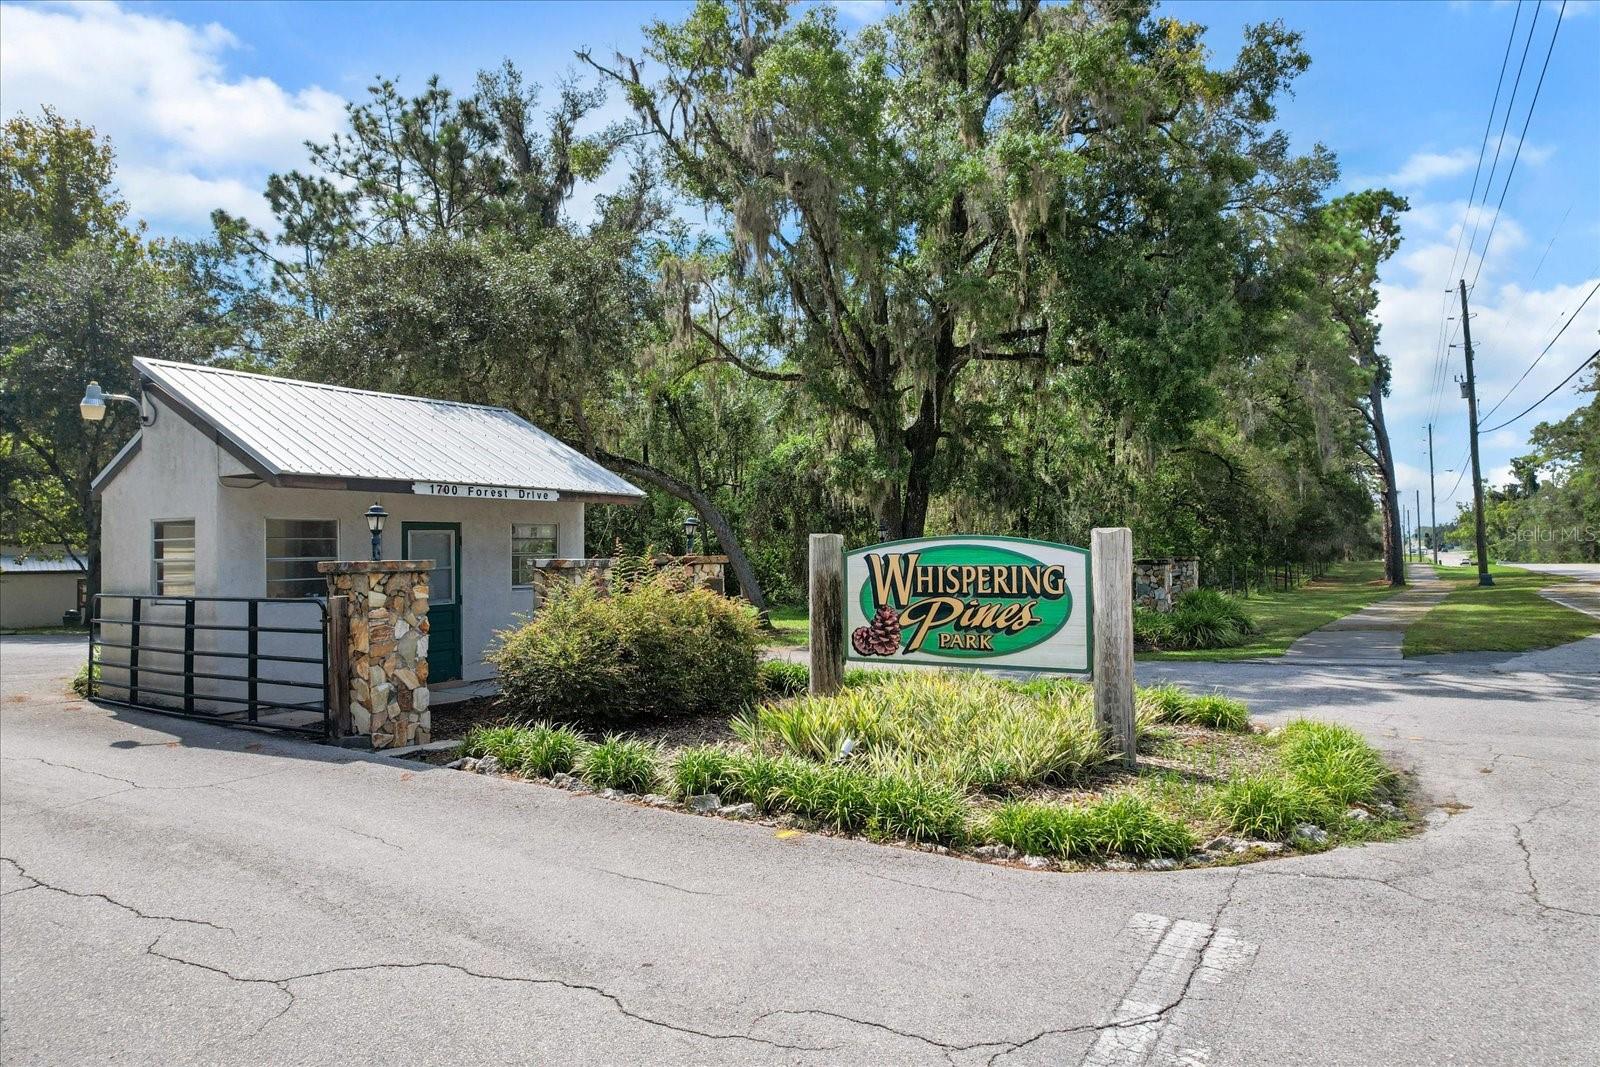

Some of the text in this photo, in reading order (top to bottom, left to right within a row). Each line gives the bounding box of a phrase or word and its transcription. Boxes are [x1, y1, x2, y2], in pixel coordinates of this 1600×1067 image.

[429, 484, 549, 500] 1700 Forest Drive
[865, 553, 1066, 606] WHISPERING
[899, 596, 1042, 655] Pines
[938, 633, 994, 651] PARK
